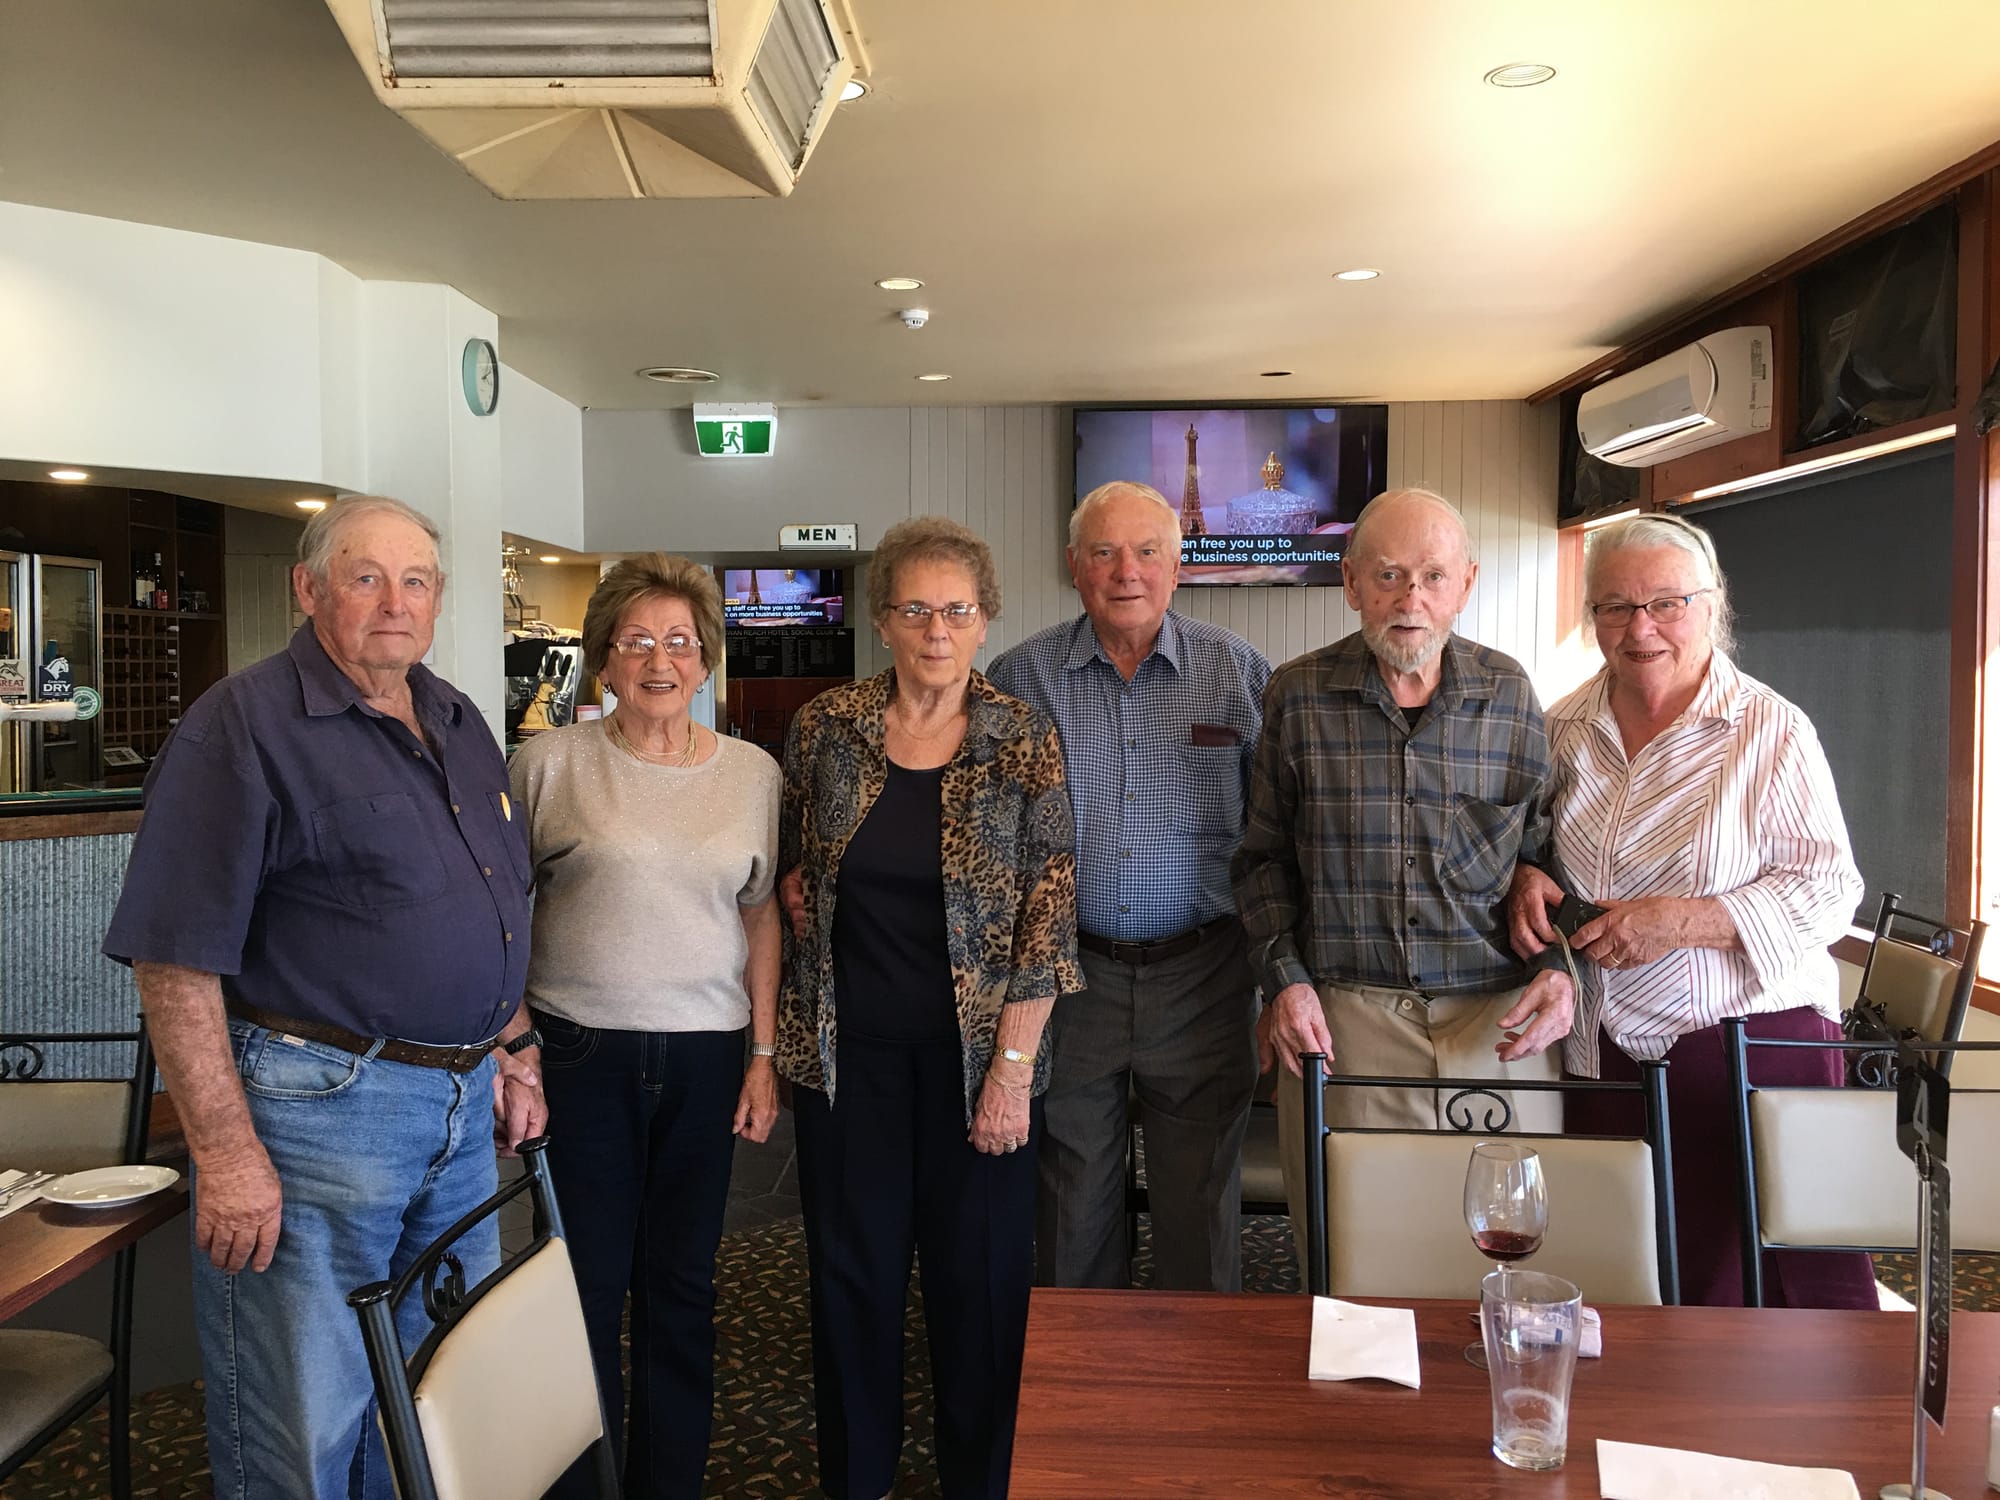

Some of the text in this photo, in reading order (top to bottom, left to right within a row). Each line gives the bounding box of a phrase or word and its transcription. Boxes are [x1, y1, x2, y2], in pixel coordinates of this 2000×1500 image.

[798, 528, 836, 541] MEN
[1181, 537, 1292, 551] an free you up to
[1192, 551, 1248, 562] business
[1251, 550, 1340, 563] opportunities
[43, 683, 71, 692] DRY
[1929, 1180, 1940, 1387] RESERVED
